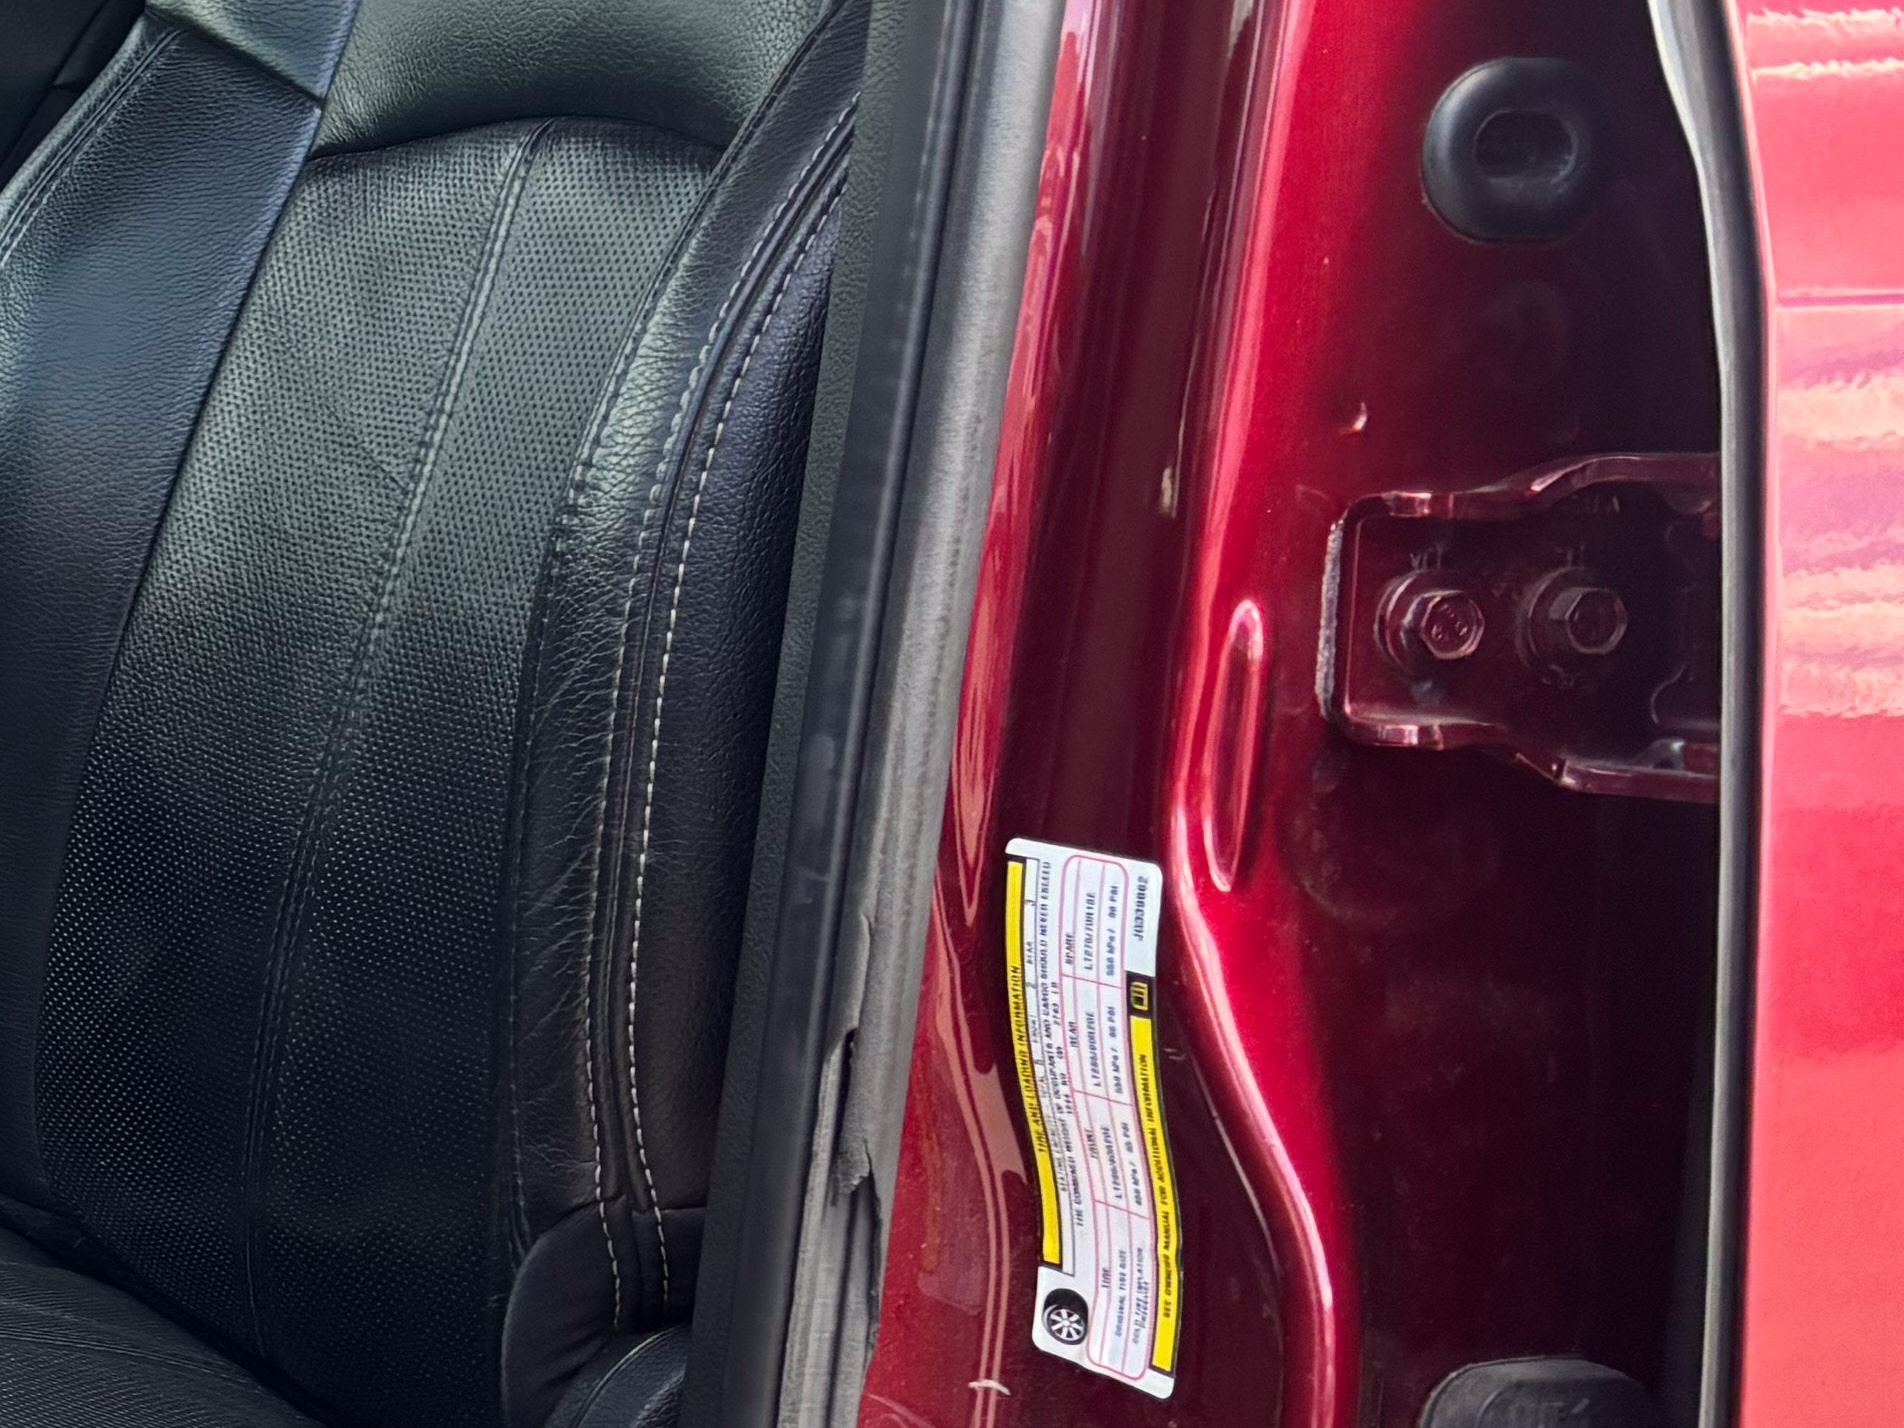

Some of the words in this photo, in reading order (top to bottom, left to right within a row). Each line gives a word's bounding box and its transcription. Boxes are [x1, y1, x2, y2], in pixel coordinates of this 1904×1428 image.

[1040, 861, 1051, 900] EXCEED
[1039, 904, 1049, 936] NEVER
[1039, 939, 1048, 979] SHOULD
[1064, 932, 1073, 965] SPARE
[1010, 965, 1026, 1046] INFORMATION
[1040, 982, 1050, 1016] CARGO
[1043, 1019, 1052, 1038] AND
[1067, 1021, 1077, 1047] REAR
[1018, 1050, 1036, 1099] LOADING
[1139, 1053, 1156, 1122] INFORMATION
[1026, 1103, 1041, 1126] AND
[1031, 1130, 1047, 1153] TIRE
[1156, 1186, 1169, 1205] FOR
